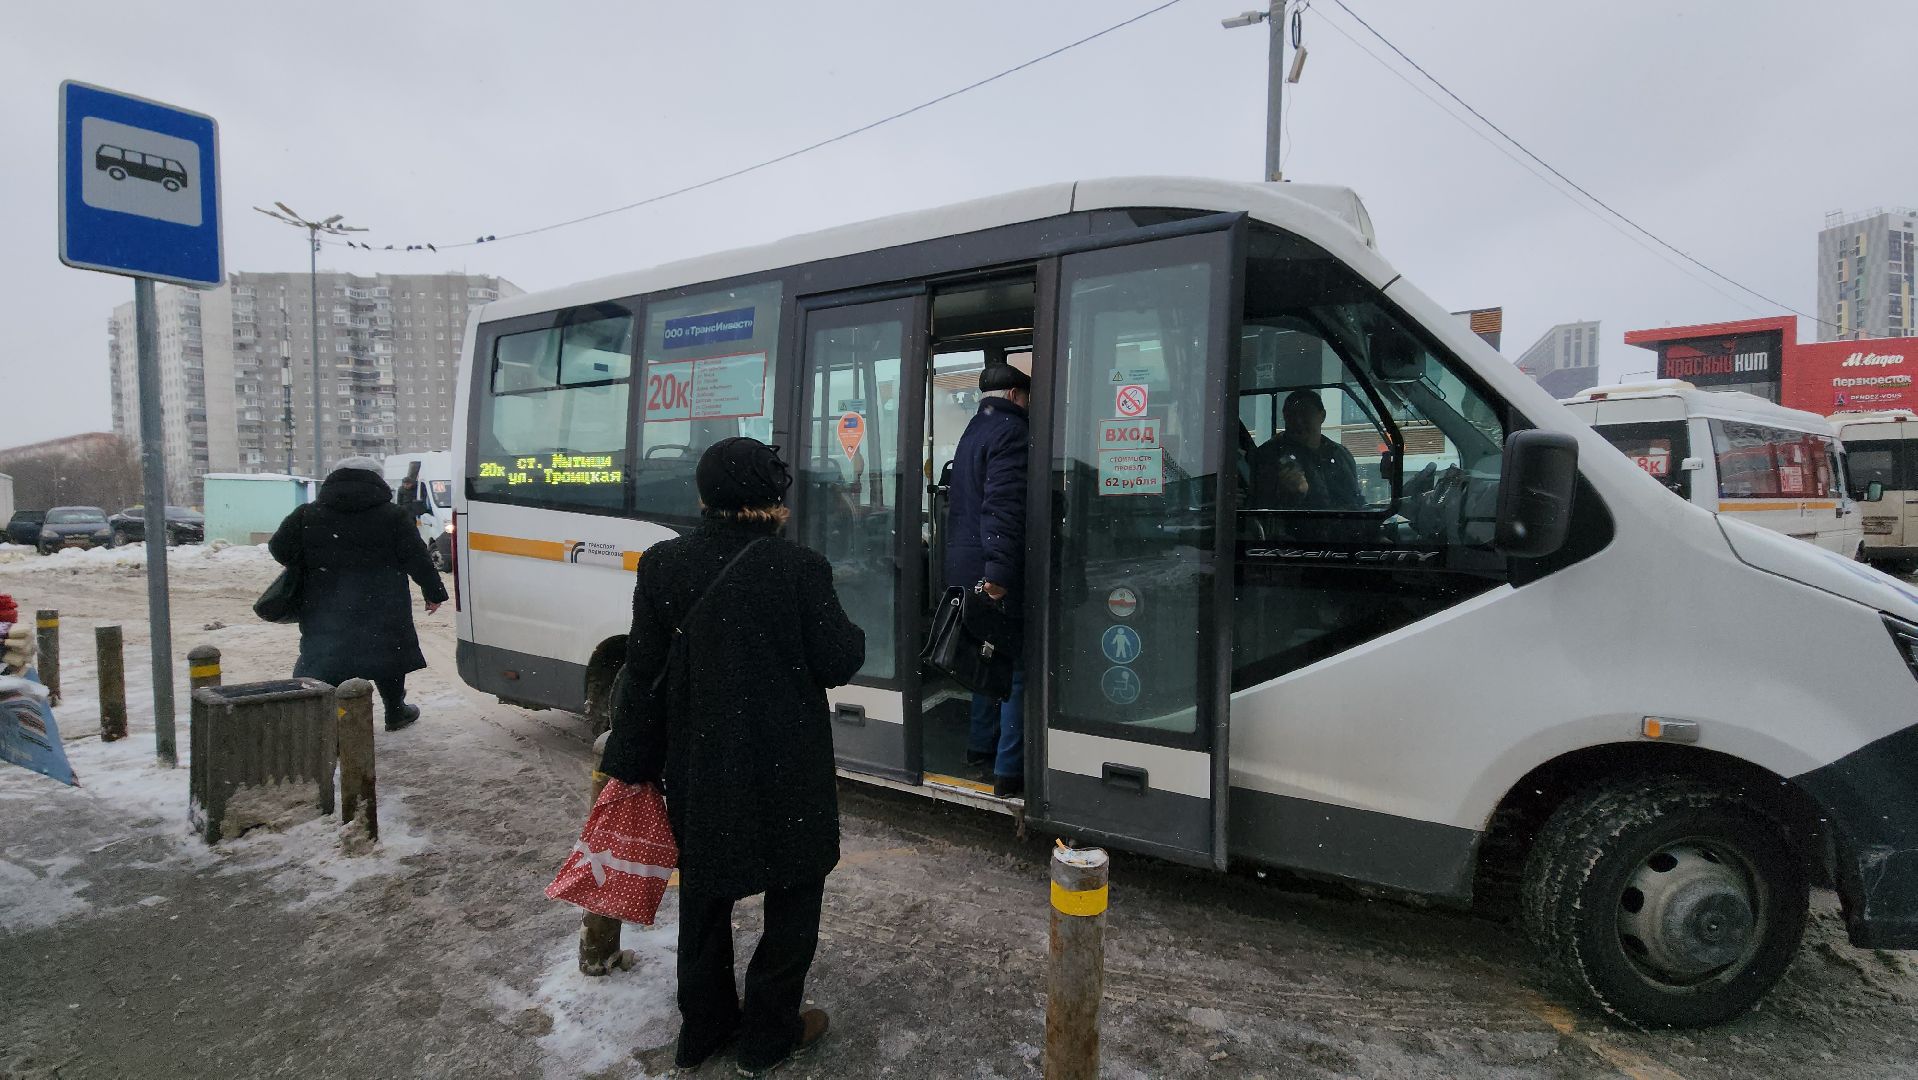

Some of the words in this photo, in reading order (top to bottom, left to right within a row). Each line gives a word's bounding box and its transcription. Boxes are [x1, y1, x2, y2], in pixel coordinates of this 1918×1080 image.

[664, 327, 683, 339] ООО
[685, 320, 753, 337] «ТрансИнвест»
[1105, 427, 1155, 443] ВХОД
[516, 457, 543, 469] ст.
[551, 453, 612, 468] Мытищи
[507, 472, 533, 485] ул.
[543, 468, 622, 485] Троицкая
[1105, 477, 1120, 487] 62
[1122, 476, 1157, 488] рубля
